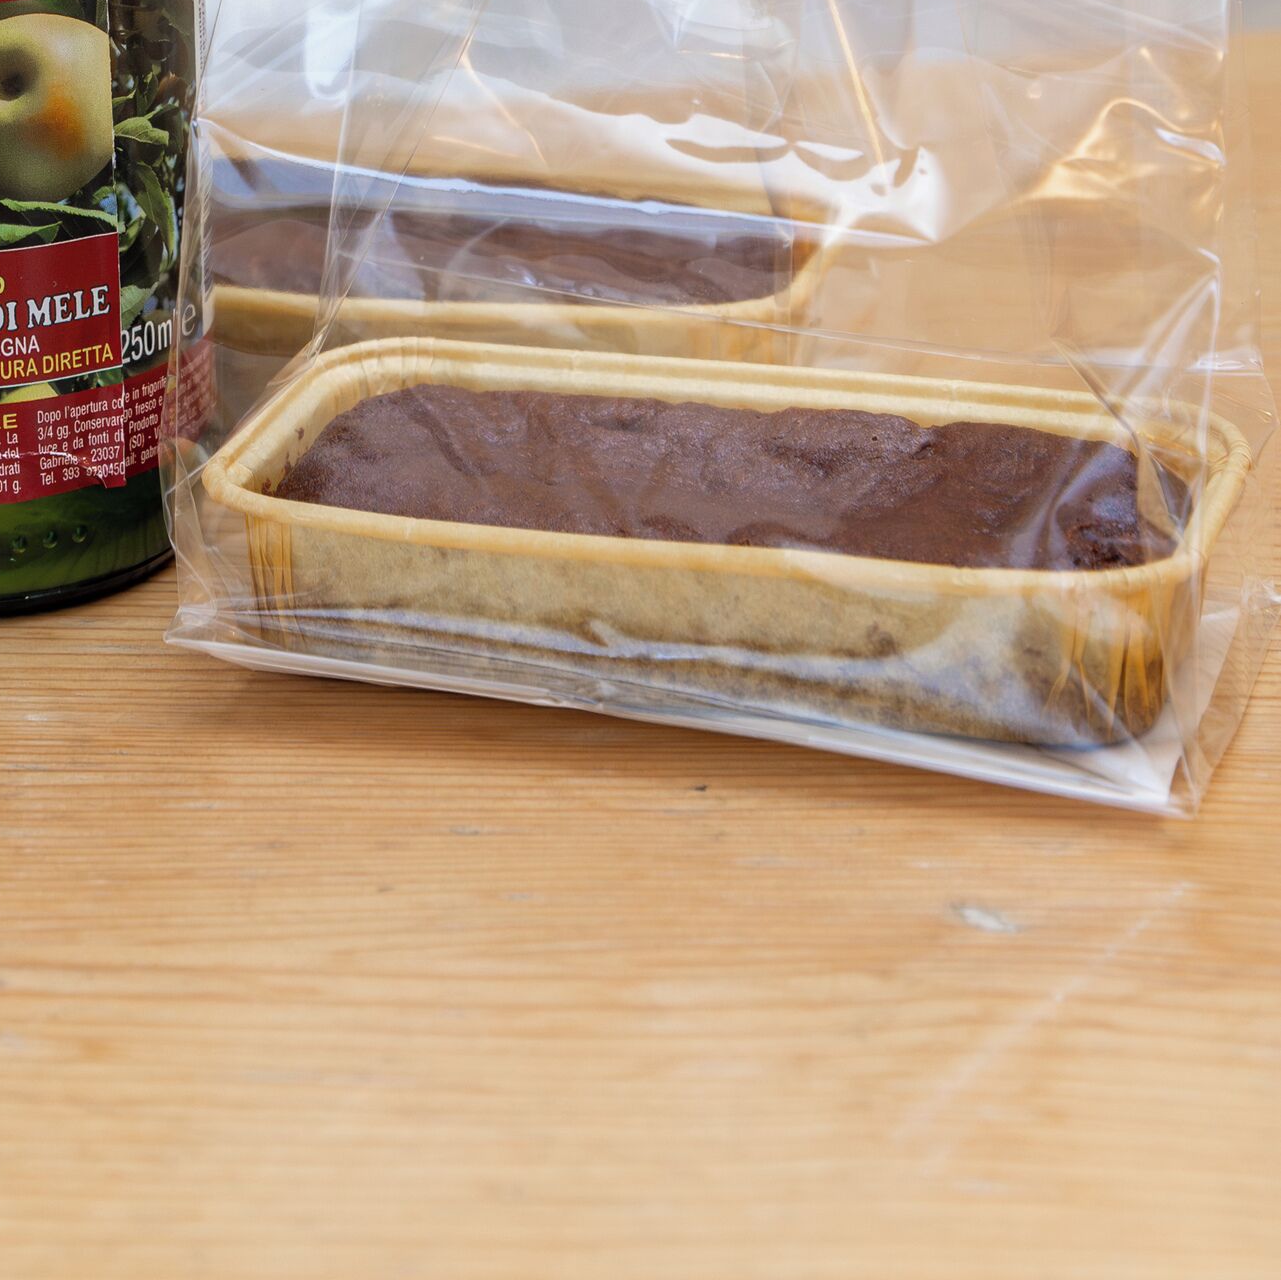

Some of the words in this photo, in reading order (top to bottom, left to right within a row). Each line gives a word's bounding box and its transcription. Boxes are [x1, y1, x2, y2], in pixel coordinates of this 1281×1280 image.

[27, 284, 112, 329] MELE
[43, 342, 114, 375] DIRETTA
[37, 409, 61, 425] Dopo
[64, 401, 108, 420] l'apertura
[132, 386, 140, 401] in
[37, 424, 54, 441] 3/4
[57, 425, 71, 441] gg.
[135, 399, 156, 417] fresco
[158, 396, 163, 407] e
[6, 431, 19, 444] La
[62, 440, 69, 452] e
[73, 436, 84, 450] da
[88, 429, 110, 447] fonti
[129, 414, 158, 434] Prodotto
[91, 445, 120, 463] 23037
[128, 432, 145, 452] (SO)
[12, 479, 22, 495] g.
[40, 471, 57, 487] Tel.
[62, 466, 80, 481] 393
